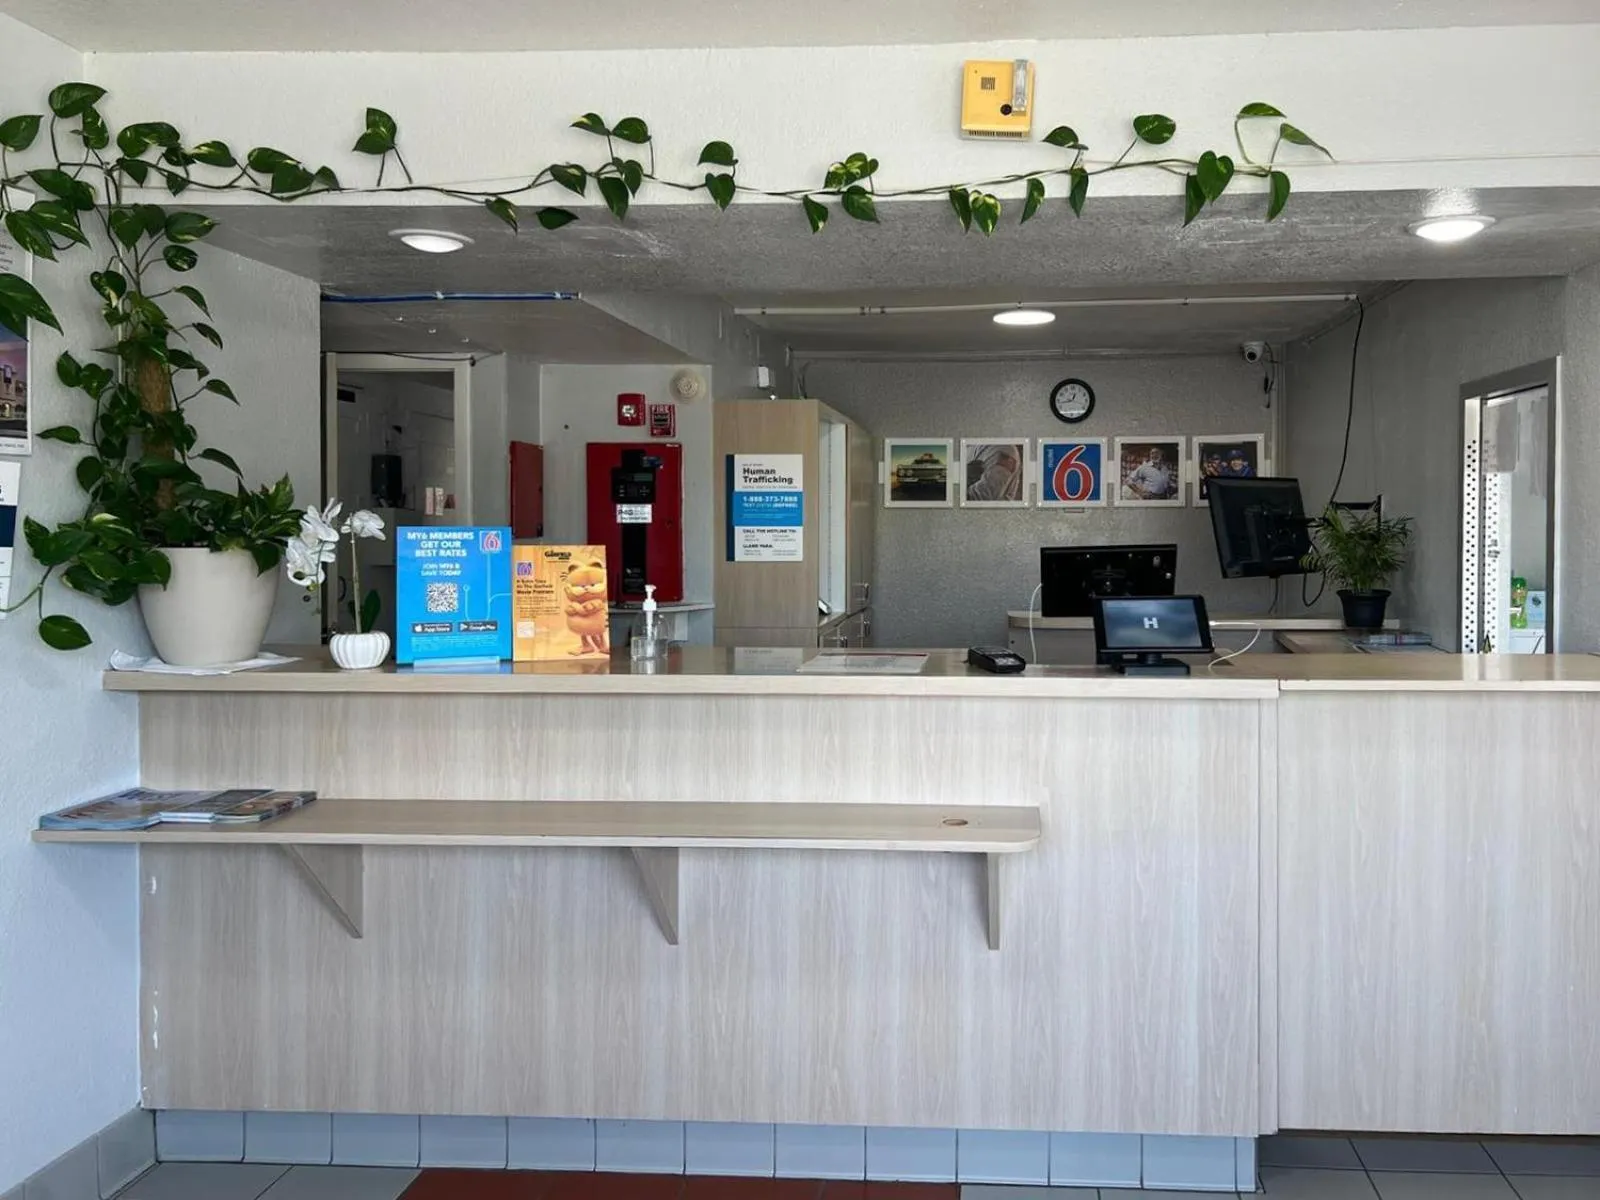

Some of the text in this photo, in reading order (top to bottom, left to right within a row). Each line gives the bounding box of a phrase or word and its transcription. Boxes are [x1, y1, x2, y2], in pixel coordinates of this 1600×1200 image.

[1053, 445, 1094, 501] 6
[743, 476, 794, 485] Trafficking
[430, 532, 475, 540] MEMBERS
[420, 541, 462, 549] GET OUR
[415, 549, 467, 557] BEST RATES
[1143, 617, 1159, 629] H
